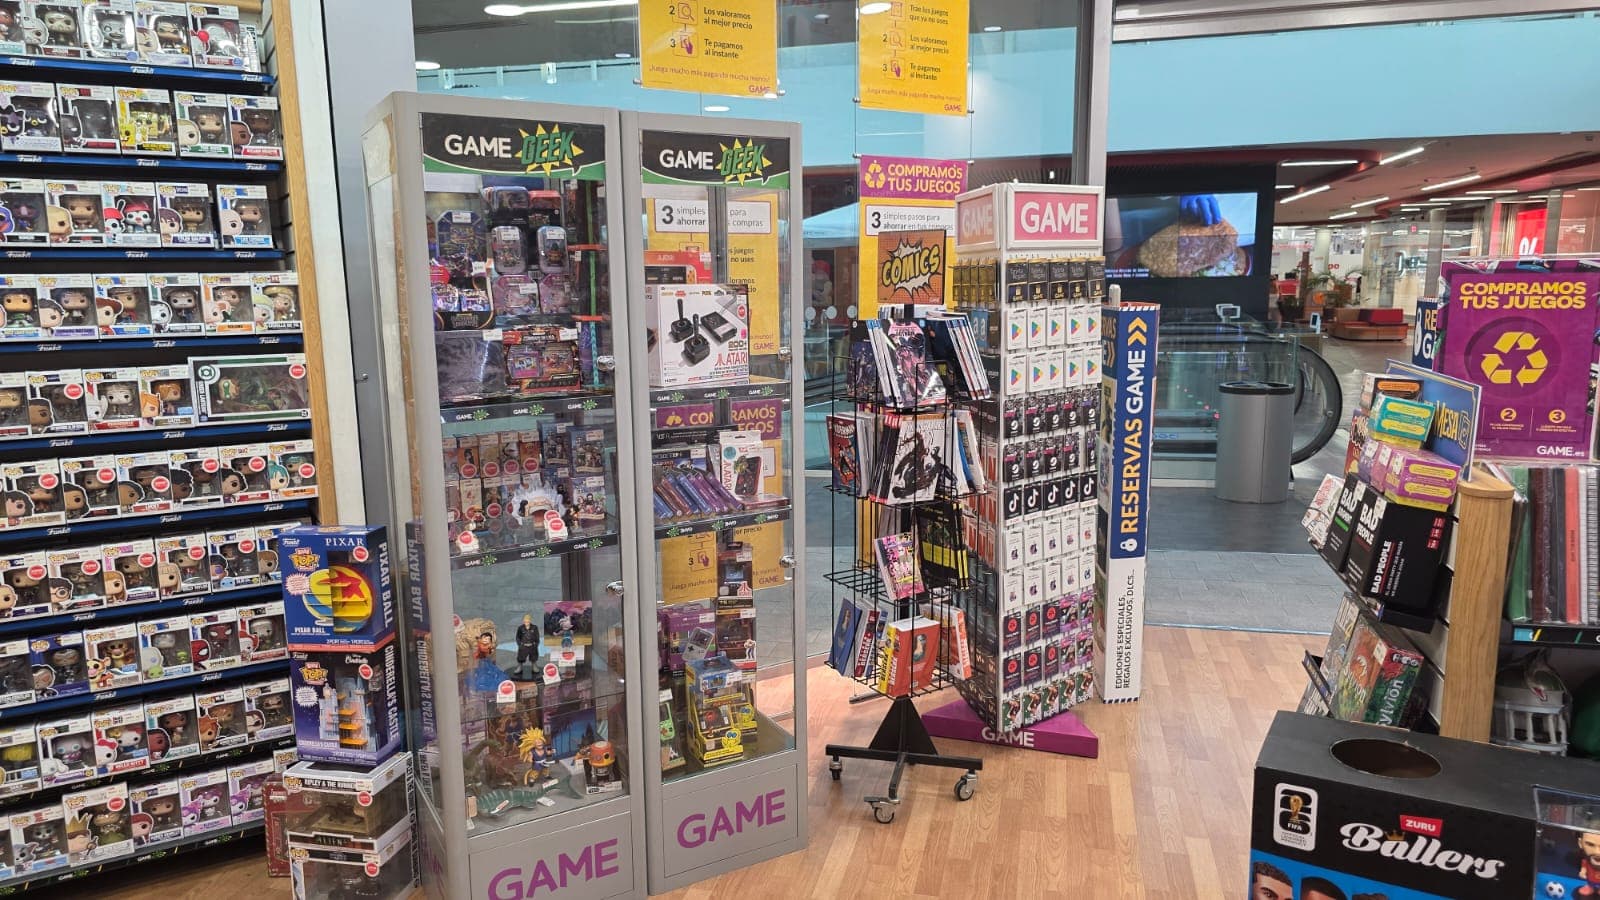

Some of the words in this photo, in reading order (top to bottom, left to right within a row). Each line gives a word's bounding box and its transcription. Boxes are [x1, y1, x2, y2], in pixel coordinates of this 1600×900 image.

[669, 6, 676, 15] 2
[704, 7, 715, 15] Los
[717, 8, 751, 20] valoramos
[704, 17, 711, 25] al
[712, 19, 732, 28] mejor
[732, 21, 753, 31] precio
[670, 39, 676, 48] 3
[704, 39, 712, 47] Te
[714, 41, 743, 51] pagamos
[712, 50, 739, 59] instante
[944, 104, 962, 112] GAME
[444, 133, 513, 159] GAME
[520, 130, 576, 165] GEEK
[659, 148, 714, 171] GAME
[720, 144, 767, 176] GEEK
[888, 163, 963, 180] COMPRAMOS
[888, 177, 913, 192] TUS
[914, 178, 961, 194] JUEGOS
[662, 205, 674, 225] 3
[676, 205, 706, 217] simples
[729, 208, 747, 218] para
[871, 211, 882, 229] 3
[883, 212, 907, 222] simples
[908, 214, 926, 223] pasos
[926, 214, 940, 223] para
[1020, 202, 1089, 234] GAME
[676, 216, 706, 226] ahorrar
[732, 220, 764, 230] compras
[884, 220, 906, 230] ahorrar
[962, 203, 994, 239] GAME
[882, 244, 941, 288] COMICS
[1460, 282, 1587, 296] COMPRAMOS
[1460, 296, 1500, 310] TUS
[1502, 295, 1587, 310] JUEGOS
[754, 342, 774, 350] GAME
[726, 352, 748, 366] ATARI
[1126, 350, 1146, 414] GAME
[456, 412, 473, 421] GAME
[1436, 401, 1460, 441] MESA
[1504, 410, 1513, 420] 2
[1552, 411, 1563, 422] 3
[1536, 446, 1585, 458] GAME.es
[1121, 418, 1144, 534] RESERVAS
[1340, 488, 1358, 513] BAD
[1360, 504, 1378, 531] BAD
[744, 527, 762, 536] precio
[1356, 524, 1375, 546] PEOPLE
[325, 538, 365, 546] PIXAR
[520, 550, 536, 558] GAME
[688, 558, 694, 566] 3
[1376, 540, 1393, 574] PEOPLE
[378, 542, 391, 588] PIXAR
[465, 558, 480, 568] GAME
[758, 576, 779, 585] GAME
[1371, 572, 1382, 594] BAD
[382, 590, 394, 628] BALL
[1118, 594, 1126, 645] ESPECIALES,
[1125, 597, 1134, 650] EXCLUSIVOS,
[385, 644, 397, 708] CINDERELLA'S
[1116, 646, 1124, 689] EDICIONES
[388, 706, 400, 742] CASTLE
[981, 726, 1035, 748] GAME
[676, 788, 786, 849] GAME
[1286, 822, 1302, 831] FIFA
[1404, 819, 1437, 833] ZURU
[1339, 821, 1506, 880] Ballers
[487, 838, 620, 900] GAME
